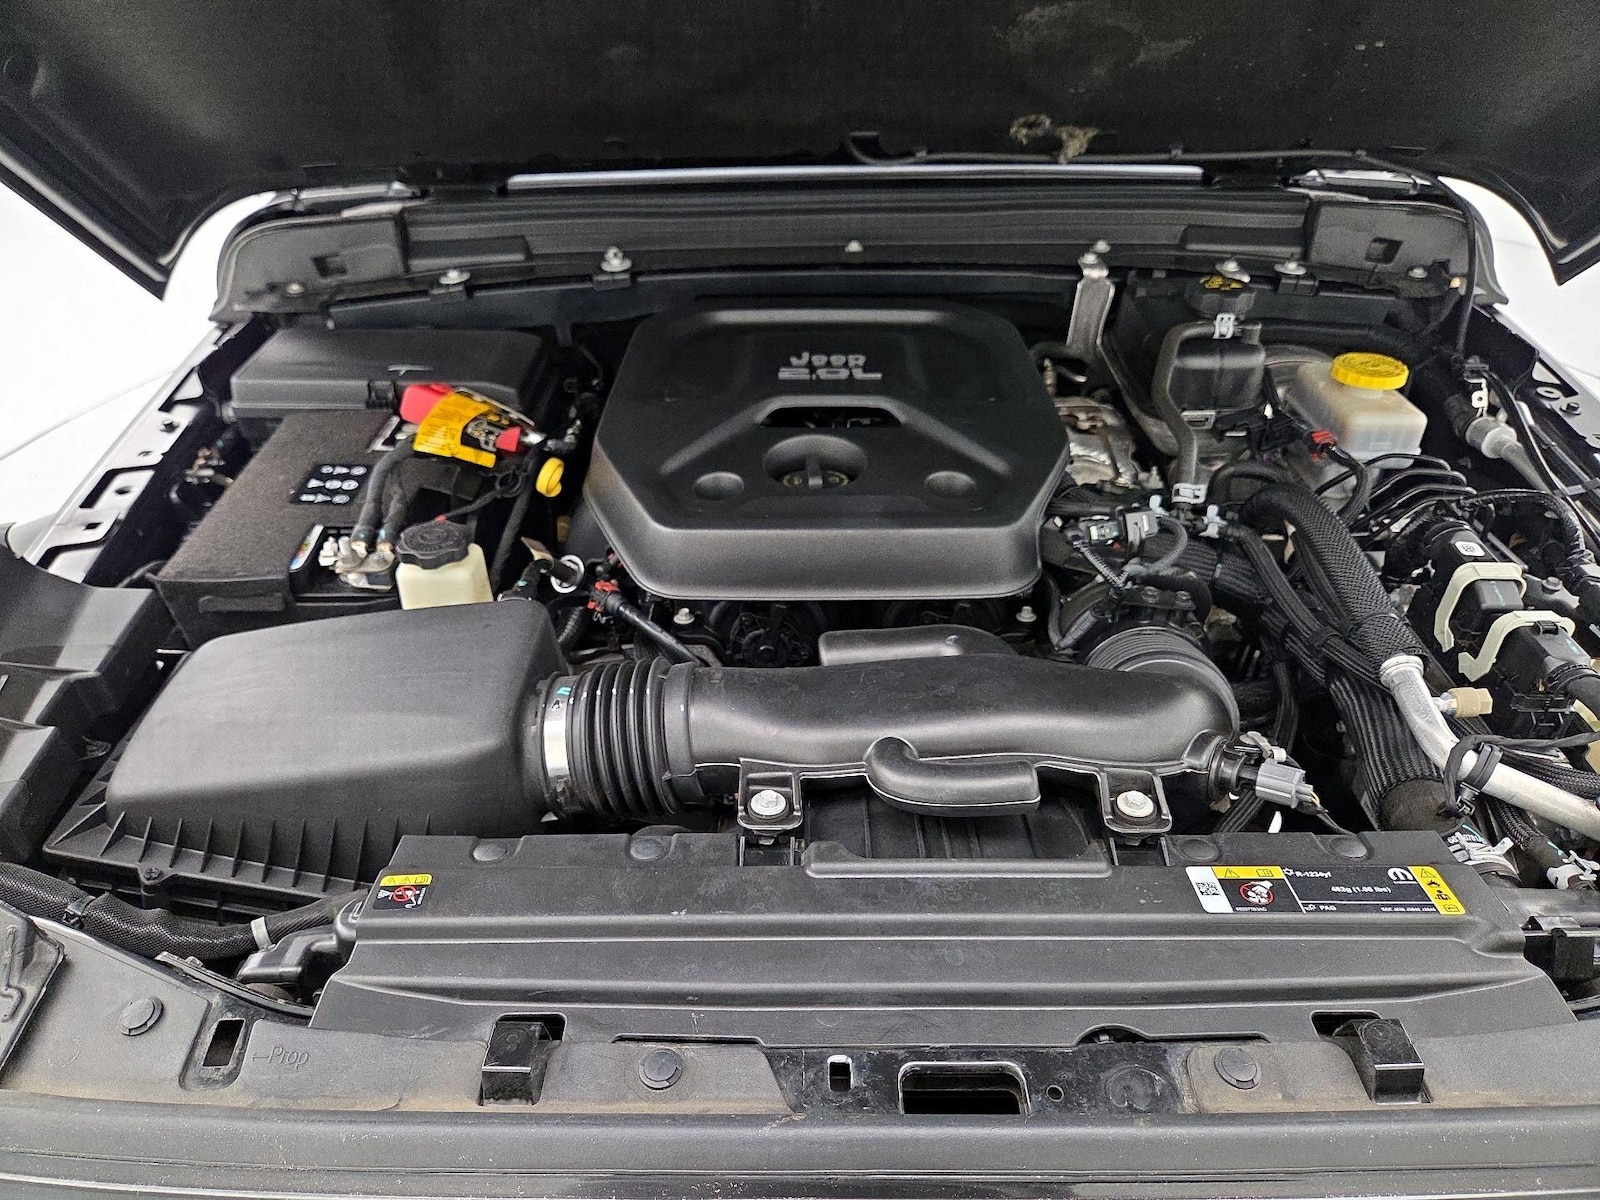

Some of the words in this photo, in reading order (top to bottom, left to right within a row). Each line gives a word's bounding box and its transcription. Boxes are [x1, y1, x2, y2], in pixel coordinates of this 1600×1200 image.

[789, 352, 866, 368] Jeep
[778, 367, 882, 380] 2.0L
[268, 1046, 309, 1071] Prop
